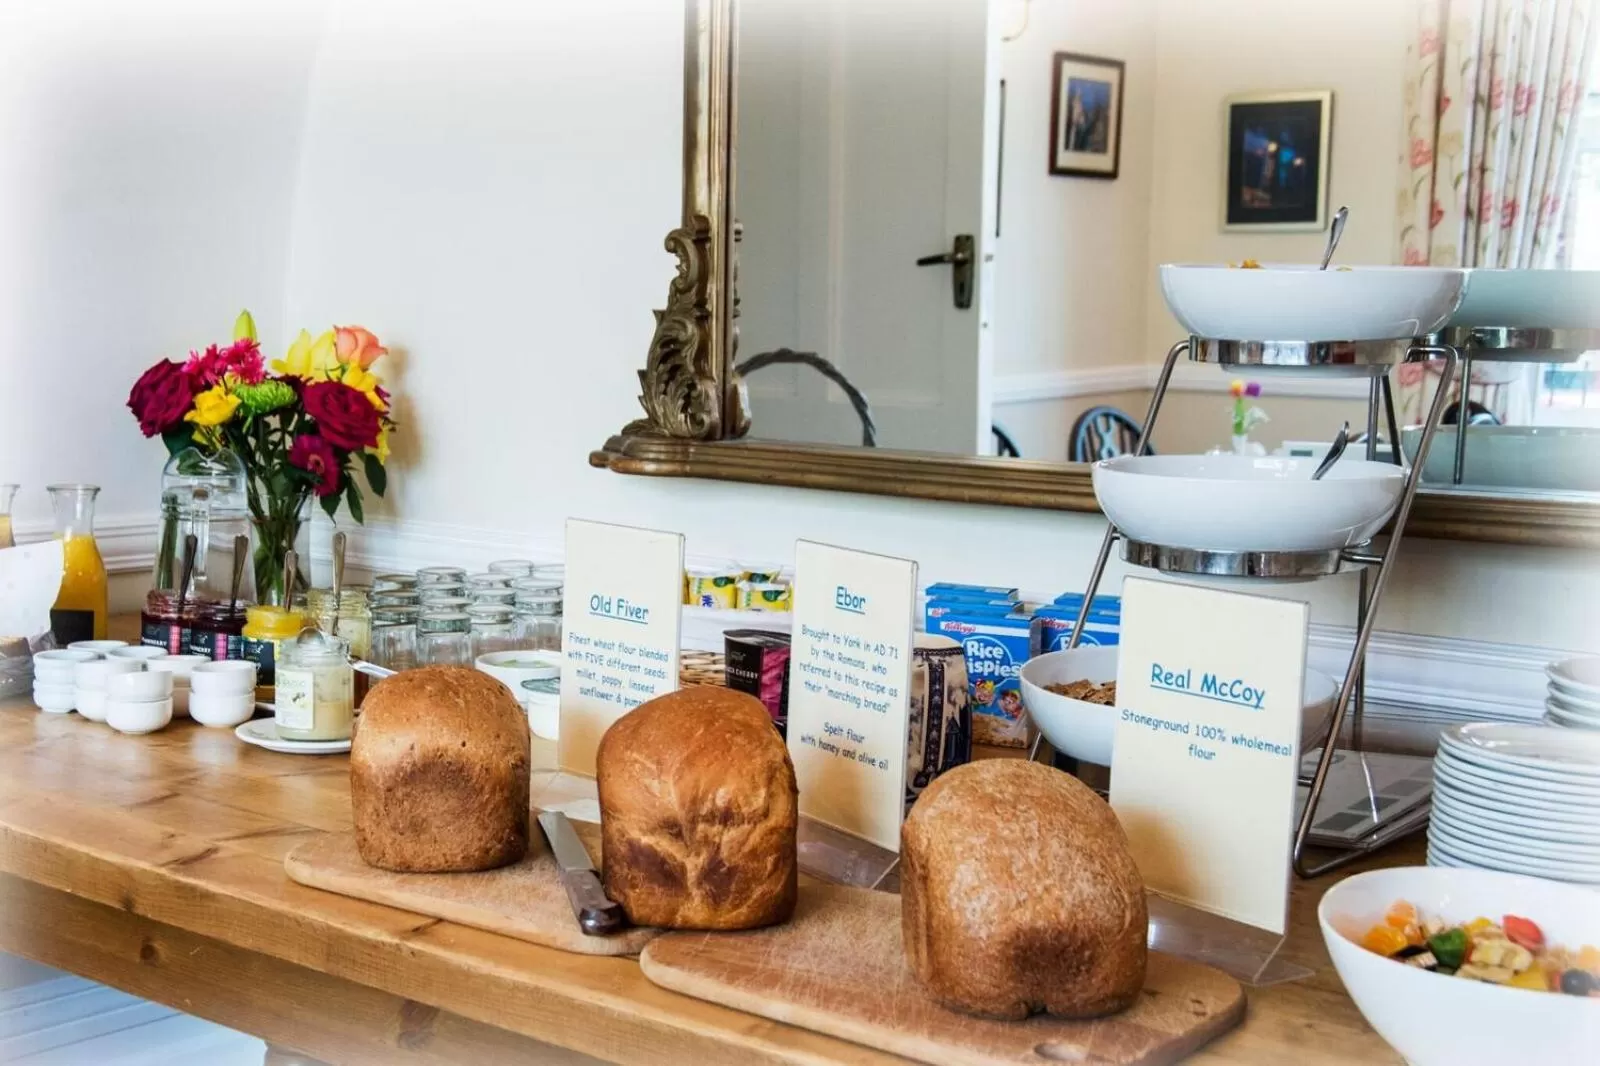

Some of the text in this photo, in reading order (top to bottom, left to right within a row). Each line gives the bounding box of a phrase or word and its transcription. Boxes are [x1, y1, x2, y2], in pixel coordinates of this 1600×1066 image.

[590, 595, 649, 619] Old Fiver
[836, 586, 866, 608] Ebor
[568, 632, 669, 662] Finest wheat flour blended
[801, 624, 899, 659] Brought to York in AD 71
[966, 640, 1004, 659] Rice
[568, 650, 582, 660] with
[585, 652, 604, 666] FIVE
[606, 659, 641, 673] different
[810, 646, 887, 675] by the Romans, who
[967, 658, 1021, 677] ispies
[629, 678, 655, 694] linseed
[799, 662, 898, 698] referred to this recipe as
[1151, 663, 1265, 709] Real McCoy
[579, 686, 613, 701] sunflower
[616, 694, 622, 703] &
[804, 680, 822, 692] their
[864, 699, 890, 713] bread"
[823, 721, 865, 744] Spelt flour
[1121, 709, 1292, 757] Stoneground 100% wholemeal
[800, 733, 888, 770] with honey and olive oil
[1187, 743, 1216, 761] flour
